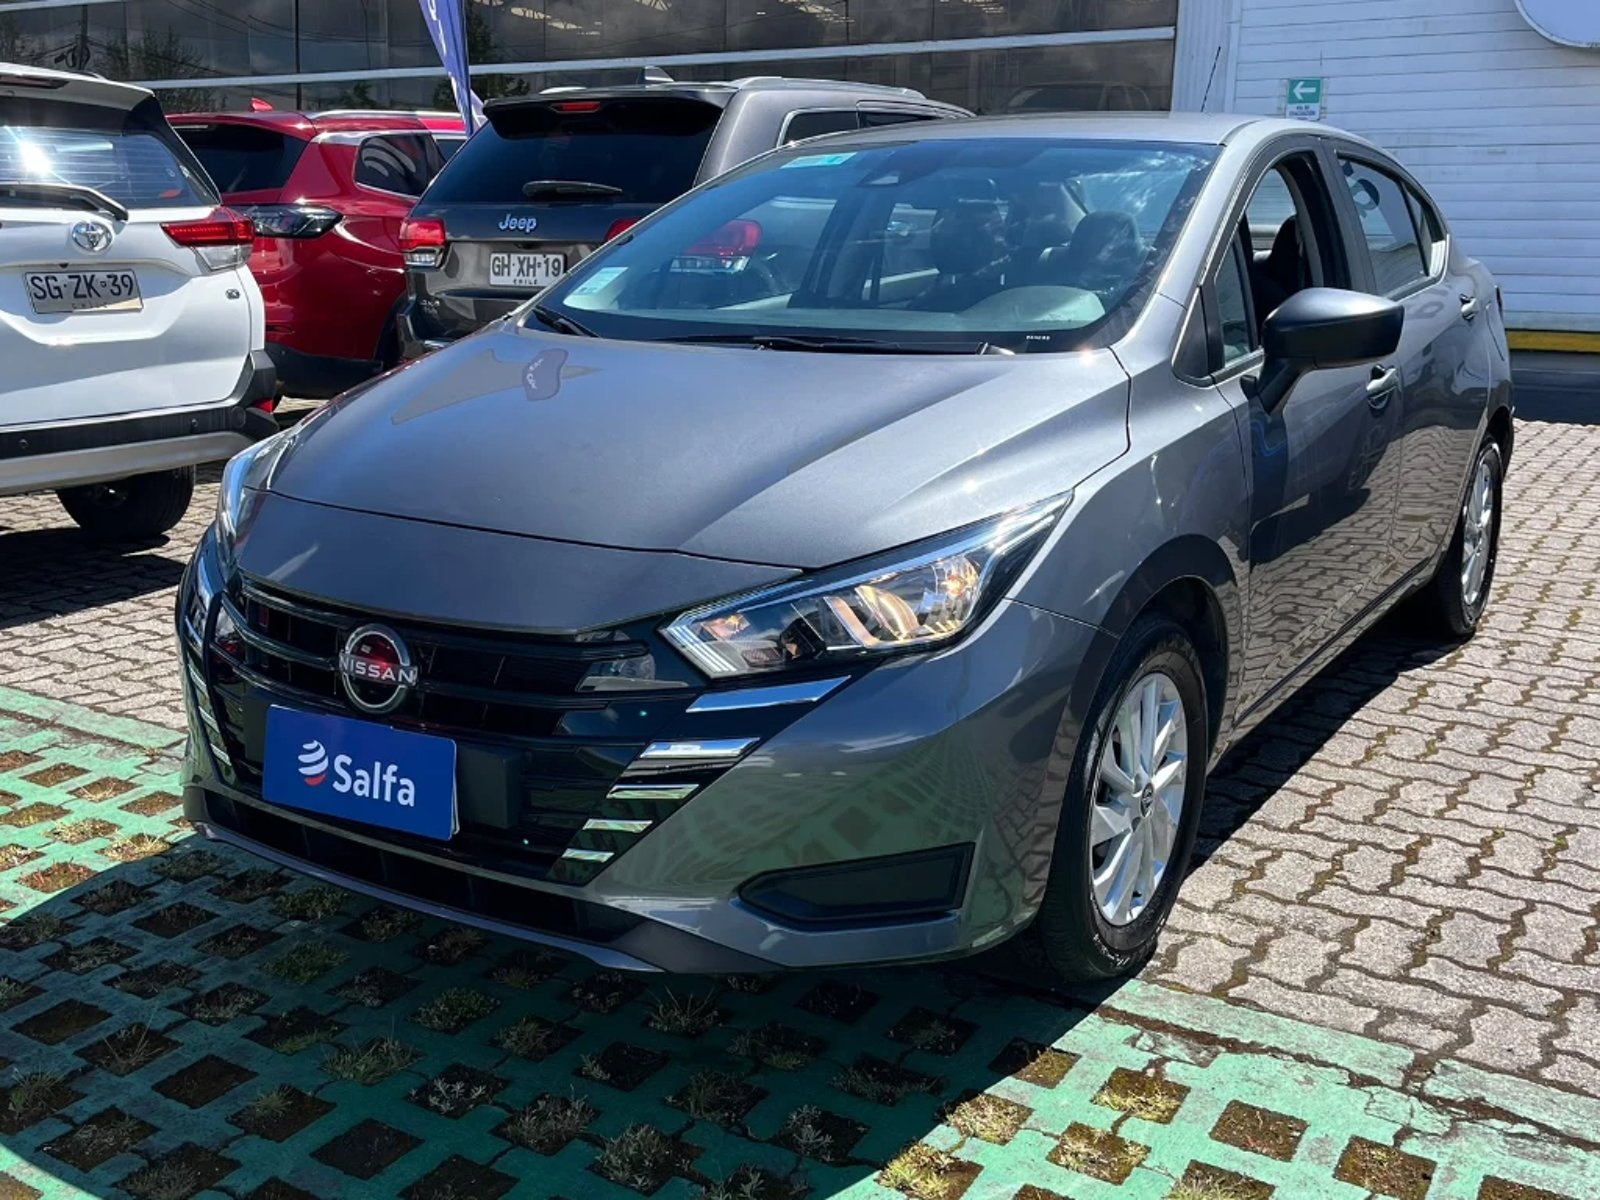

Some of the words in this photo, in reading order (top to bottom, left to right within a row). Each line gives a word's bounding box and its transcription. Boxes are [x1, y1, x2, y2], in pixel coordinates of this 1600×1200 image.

[498, 213, 537, 233] Jeep
[339, 653, 415, 684] NISSAN
[332, 754, 415, 807] Salfa
